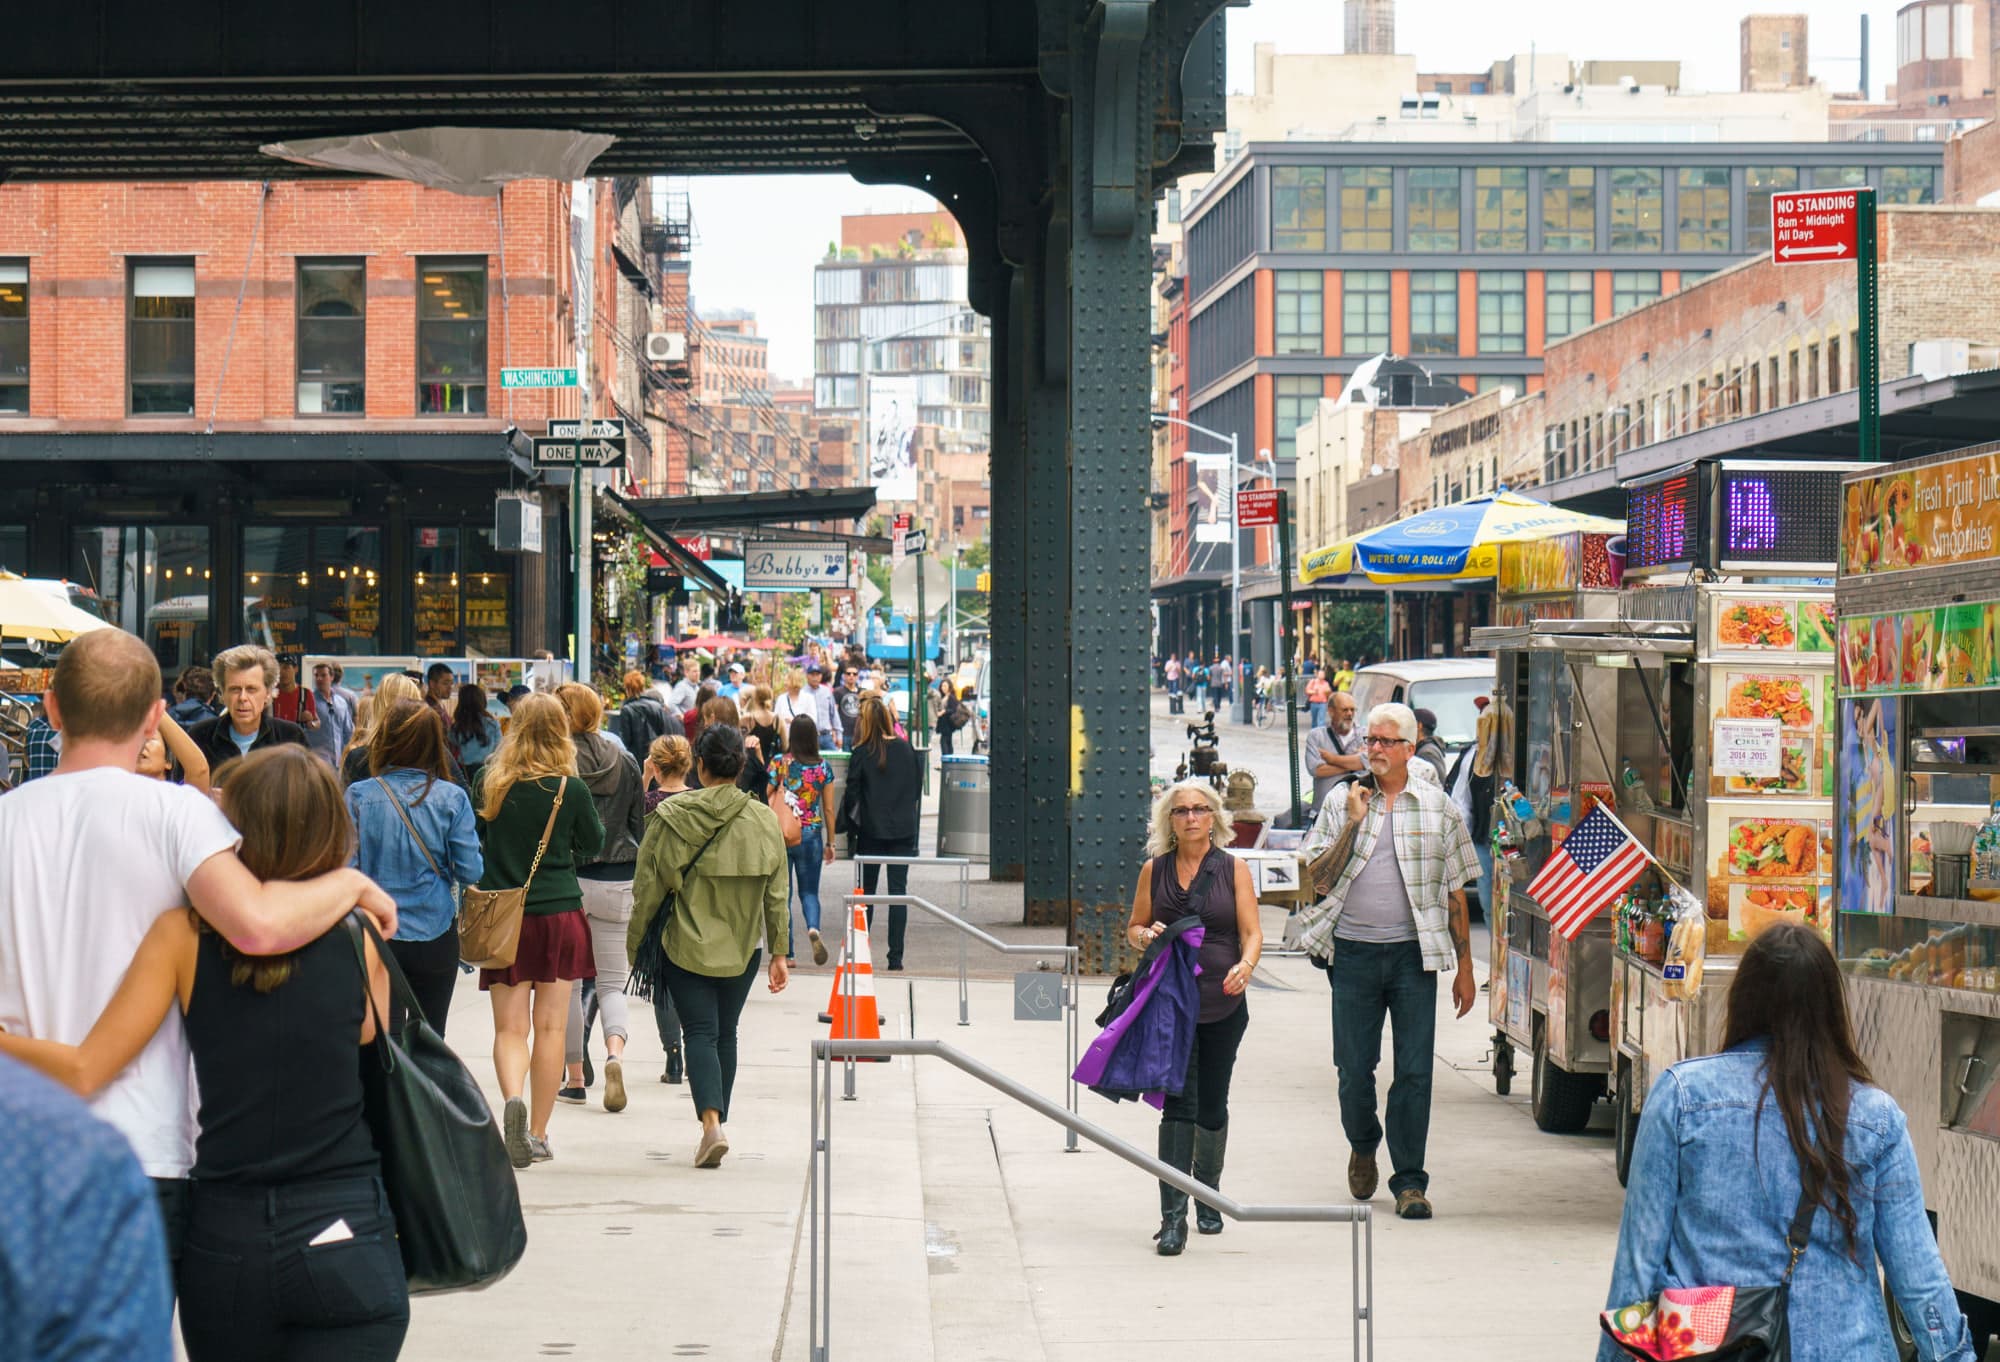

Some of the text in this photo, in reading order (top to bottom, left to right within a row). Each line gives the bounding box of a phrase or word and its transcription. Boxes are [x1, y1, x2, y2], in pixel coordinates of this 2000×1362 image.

[1777, 196, 1855, 213] NO STANDING
[1778, 217, 1797, 228] 8am
[1806, 213, 1845, 227] Midnight
[1778, 229, 1814, 241] All Days
[504, 371, 565, 386] WASHINGTON
[559, 427, 613, 436] ONE WAY
[546, 447, 612, 459] ONE WAY
[1914, 476, 1942, 512] Fresh
[1945, 471, 1974, 508] Fruit
[1951, 504, 1963, 532] &
[1932, 519, 1993, 558] Smoothies
[746, 552, 819, 578] Bubby's
[1397, 554, 1411, 564] ON
[1412, 554, 1419, 564] A
[1421, 554, 1443, 565] ROLL
[1729, 751, 1767, 760] 2014 2015
